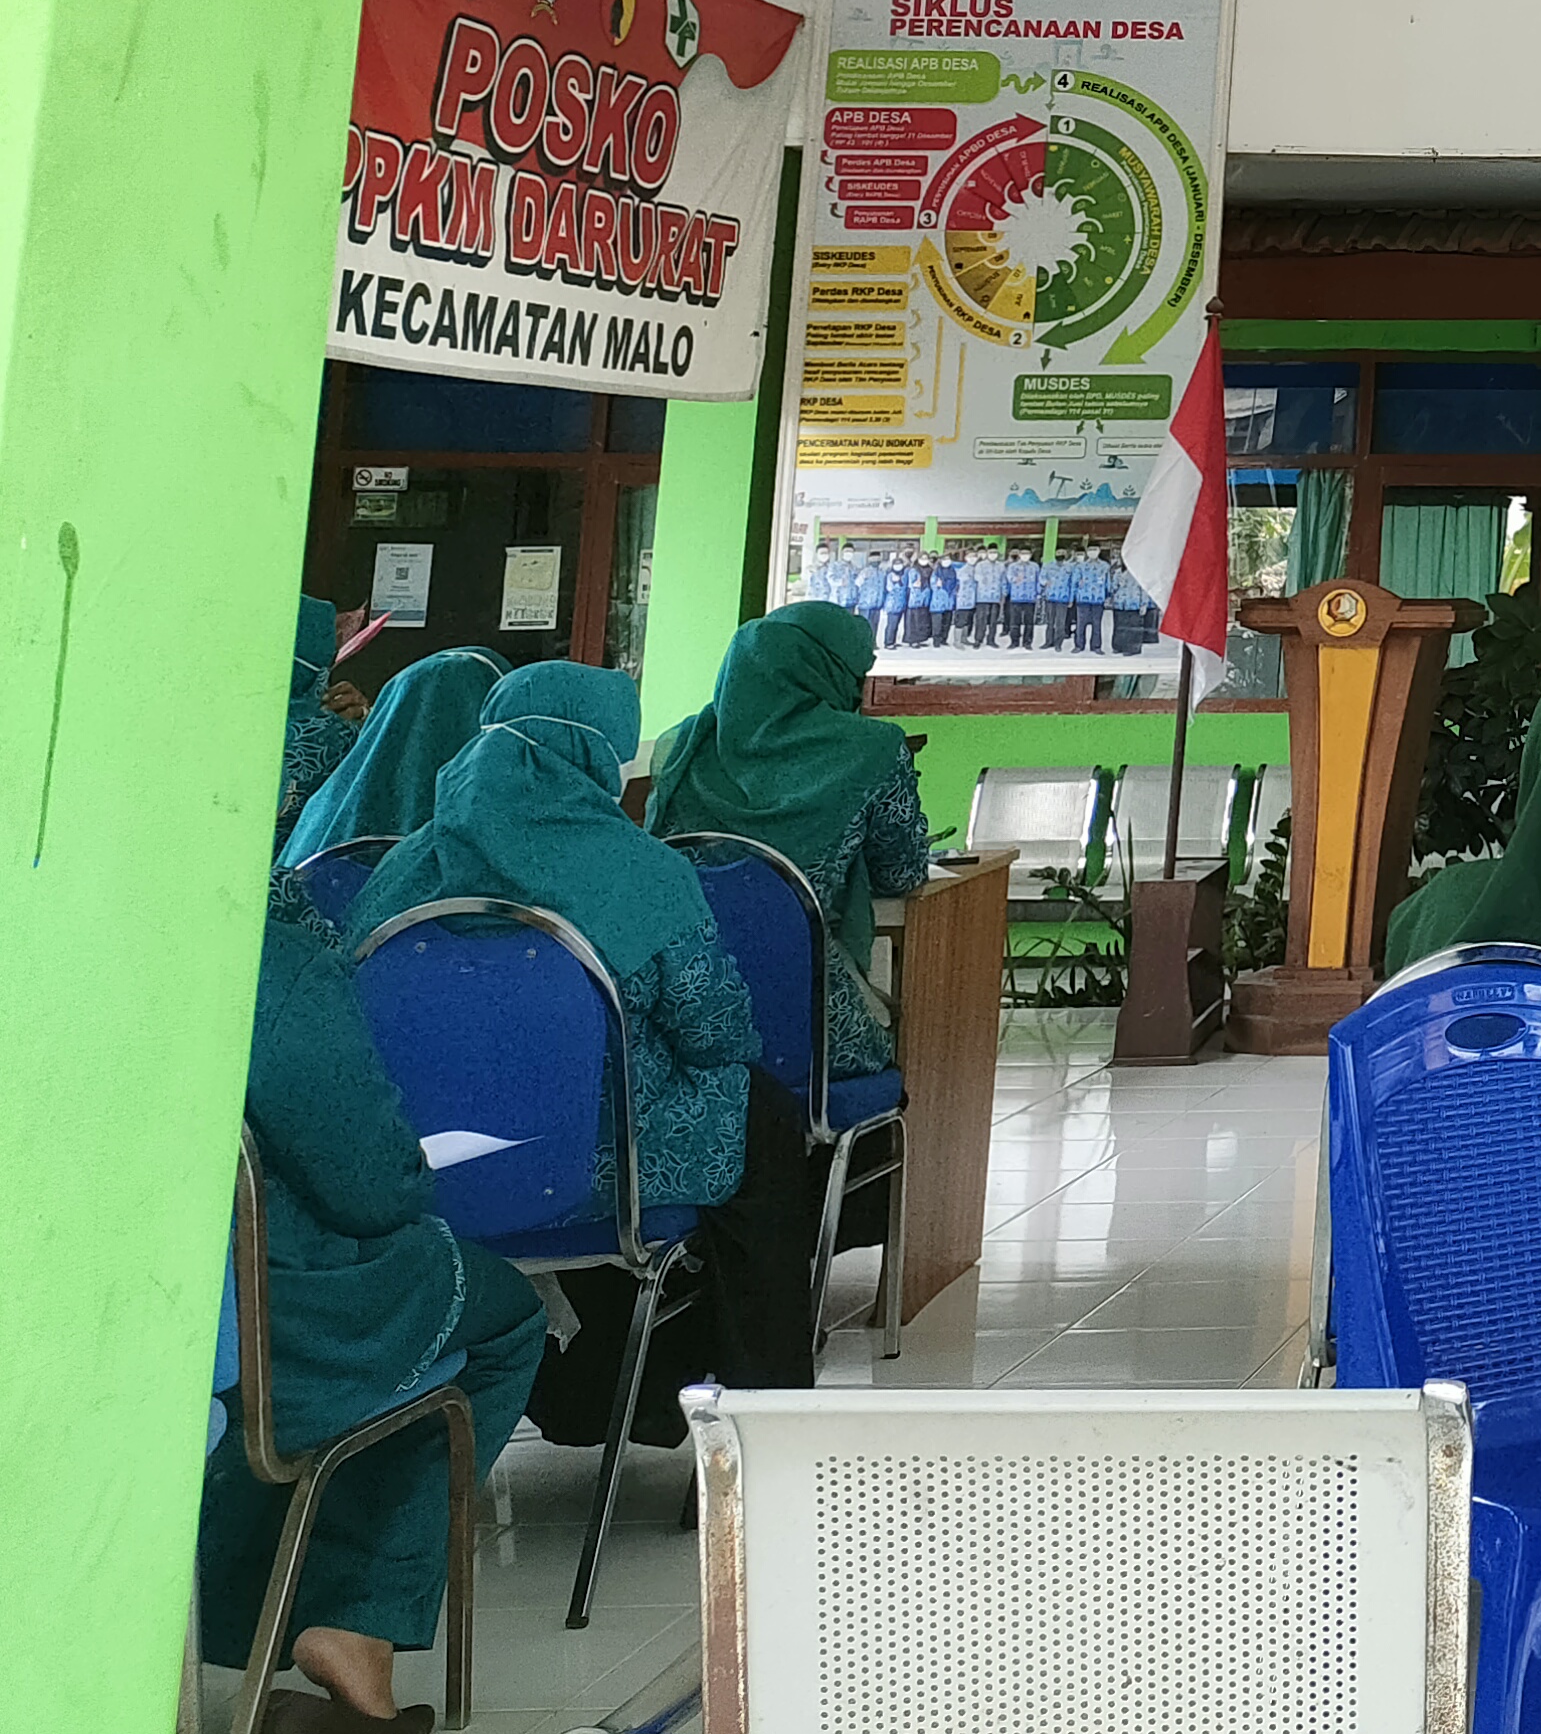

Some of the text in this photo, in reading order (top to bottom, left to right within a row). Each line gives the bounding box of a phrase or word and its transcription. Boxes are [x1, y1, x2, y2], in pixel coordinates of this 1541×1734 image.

[890, 18, 1185, 40] PERENCANAAN DESA
[838, 57, 979, 70] REALISASI APB DESA
[1057, 74, 1069, 88] 4
[435, 16, 681, 196] POSKO
[1081, 81, 1148, 115] REALISASI
[831, 111, 911, 123] APB DESA
[1144, 113, 1170, 134] APB
[1167, 133, 1189, 164] DESA
[873, 158, 891, 166] APB
[894, 158, 915, 166] Desa
[923, 213, 932, 225] 3
[985, 125, 1018, 143] DESA
[1119, 146, 1162, 236] MUSYAWARAH
[505, 171, 740, 306] DARURAT
[812, 252, 876, 260] SISKEUDES
[1140, 241, 1160, 275] DESA
[1167, 233, 1204, 307] DESEMBER)
[851, 287, 875, 296] RKP
[877, 288, 903, 296] Desa
[336, 269, 694, 377] KECAMATAN MALO
[953, 305, 974, 323] RKP
[973, 320, 1002, 339] DESA
[1012, 332, 1022, 345] 2
[1024, 378, 1090, 390] MUSDES
[800, 398, 843, 406] RKP DESA
[861, 439, 884, 447] PAGU
